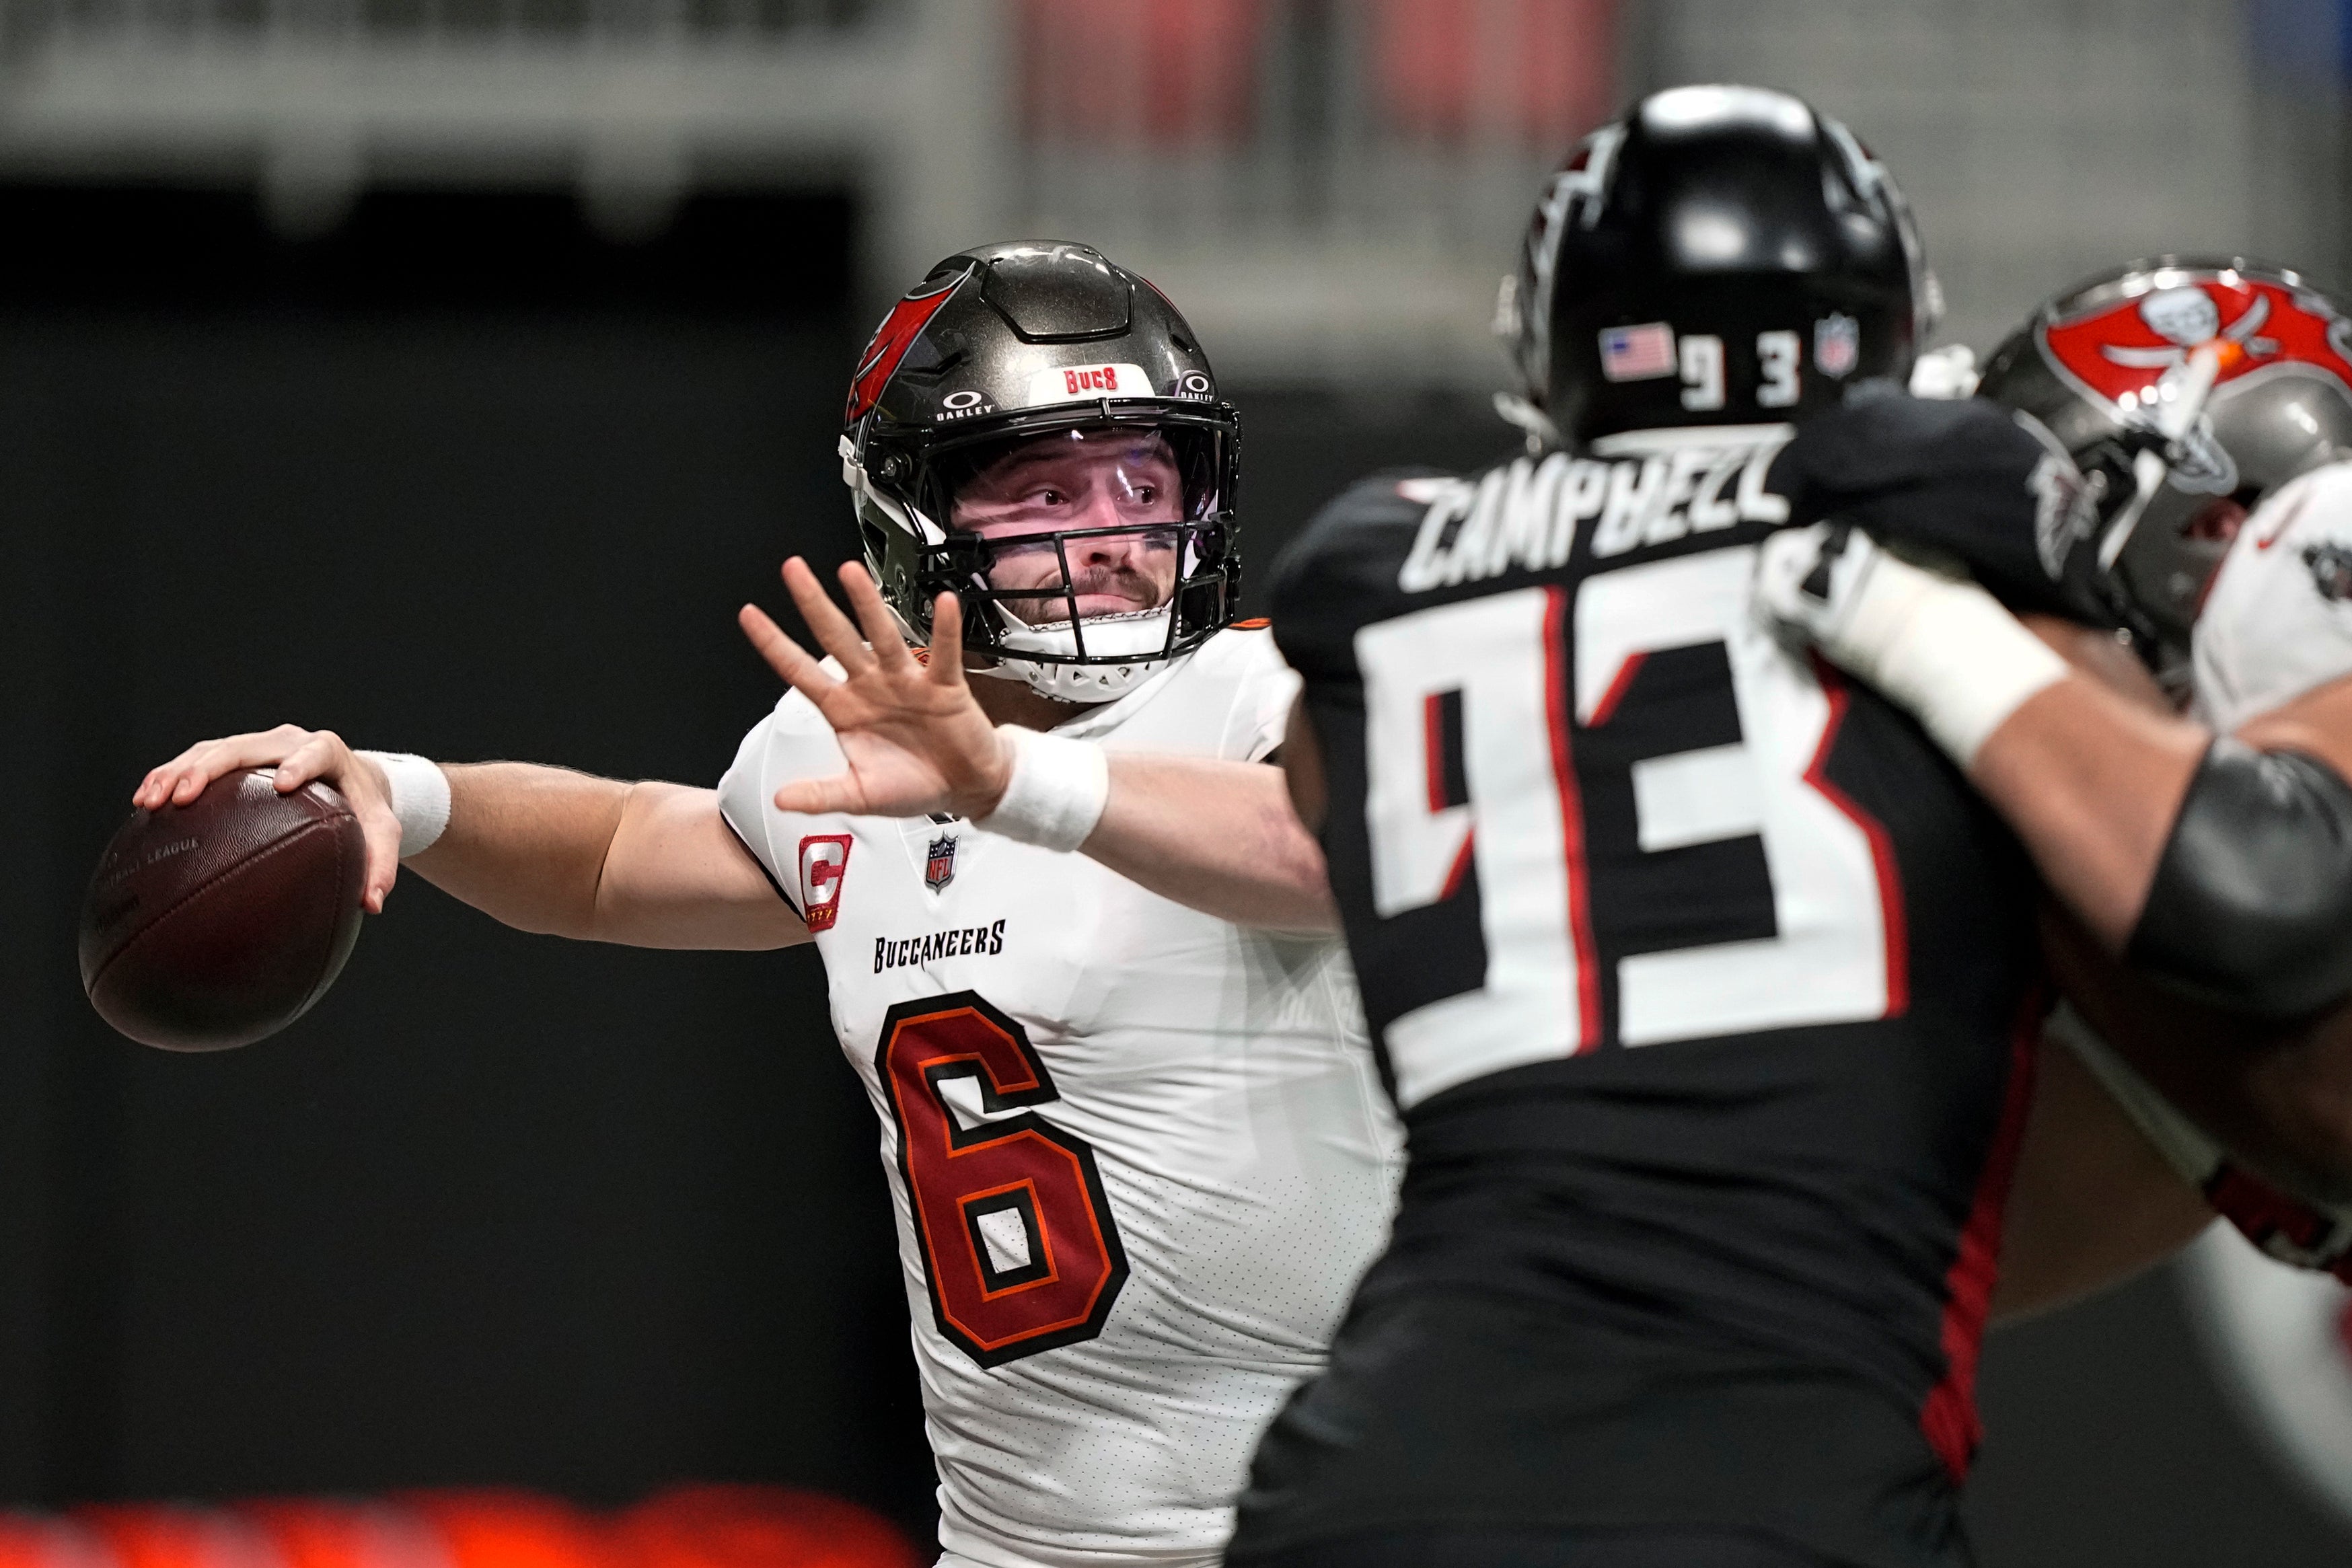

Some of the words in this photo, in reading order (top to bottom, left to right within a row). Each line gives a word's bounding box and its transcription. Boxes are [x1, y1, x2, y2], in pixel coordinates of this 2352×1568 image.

[936, 404, 995, 422] OAKLEY
[1398, 447, 1792, 594] CAMPBELL
[1354, 542, 1909, 1110] 93
[802, 842, 844, 906] C
[928, 858, 950, 881] NFL
[874, 919, 1006, 974] BUCCANEERS
[874, 990, 1130, 1370] 6
